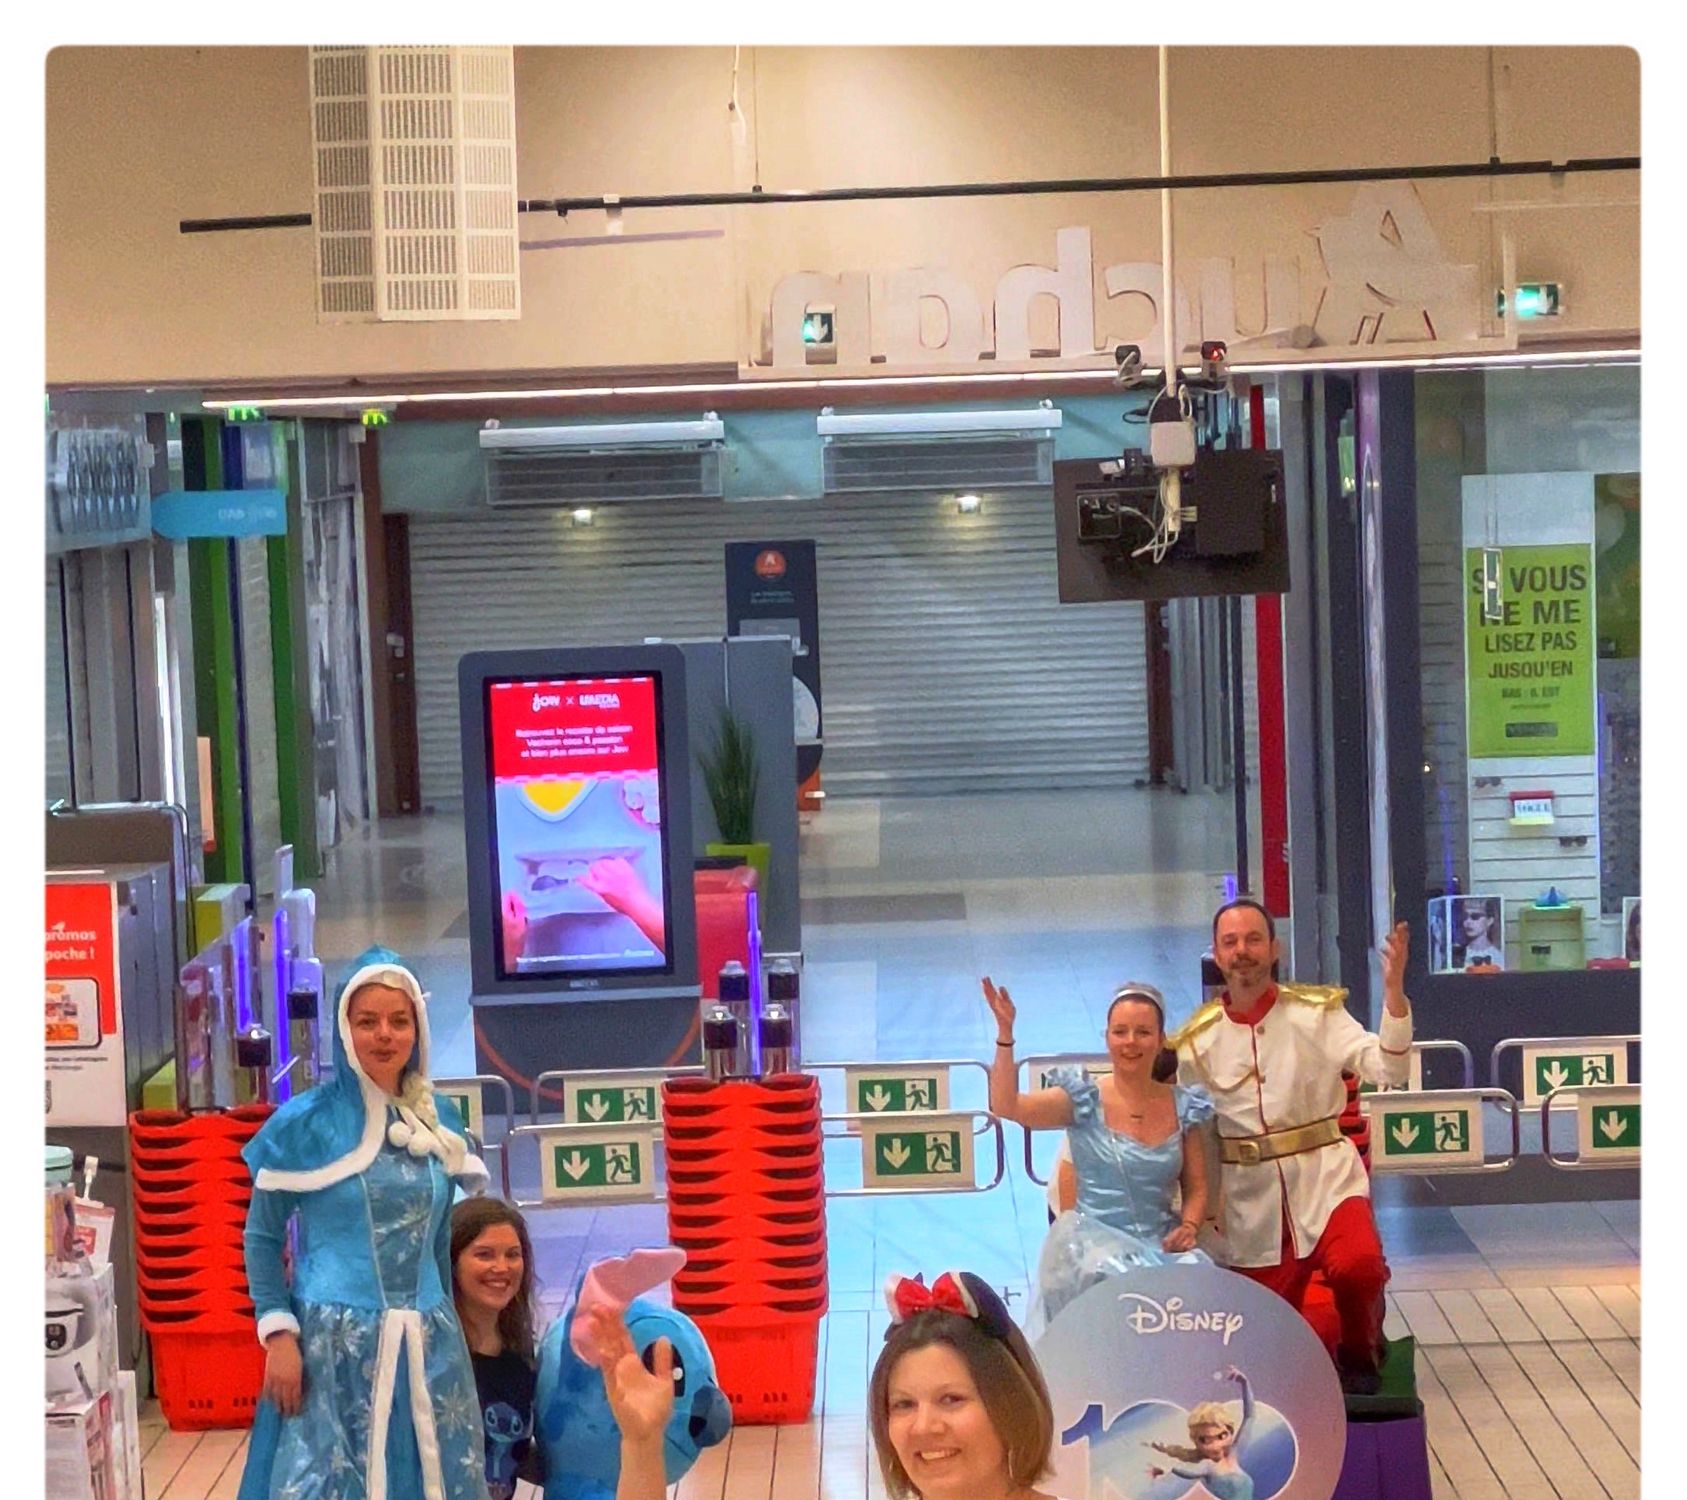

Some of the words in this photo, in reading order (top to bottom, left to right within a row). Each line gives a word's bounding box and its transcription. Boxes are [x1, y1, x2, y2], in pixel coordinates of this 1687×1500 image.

[1509, 565, 1587, 593] VOUS
[1533, 599, 1581, 624] ME
[1485, 632, 1535, 653] LISEZ
[1541, 630, 1577, 651] PAS
[1488, 660, 1573, 679] JUSQU'EN
